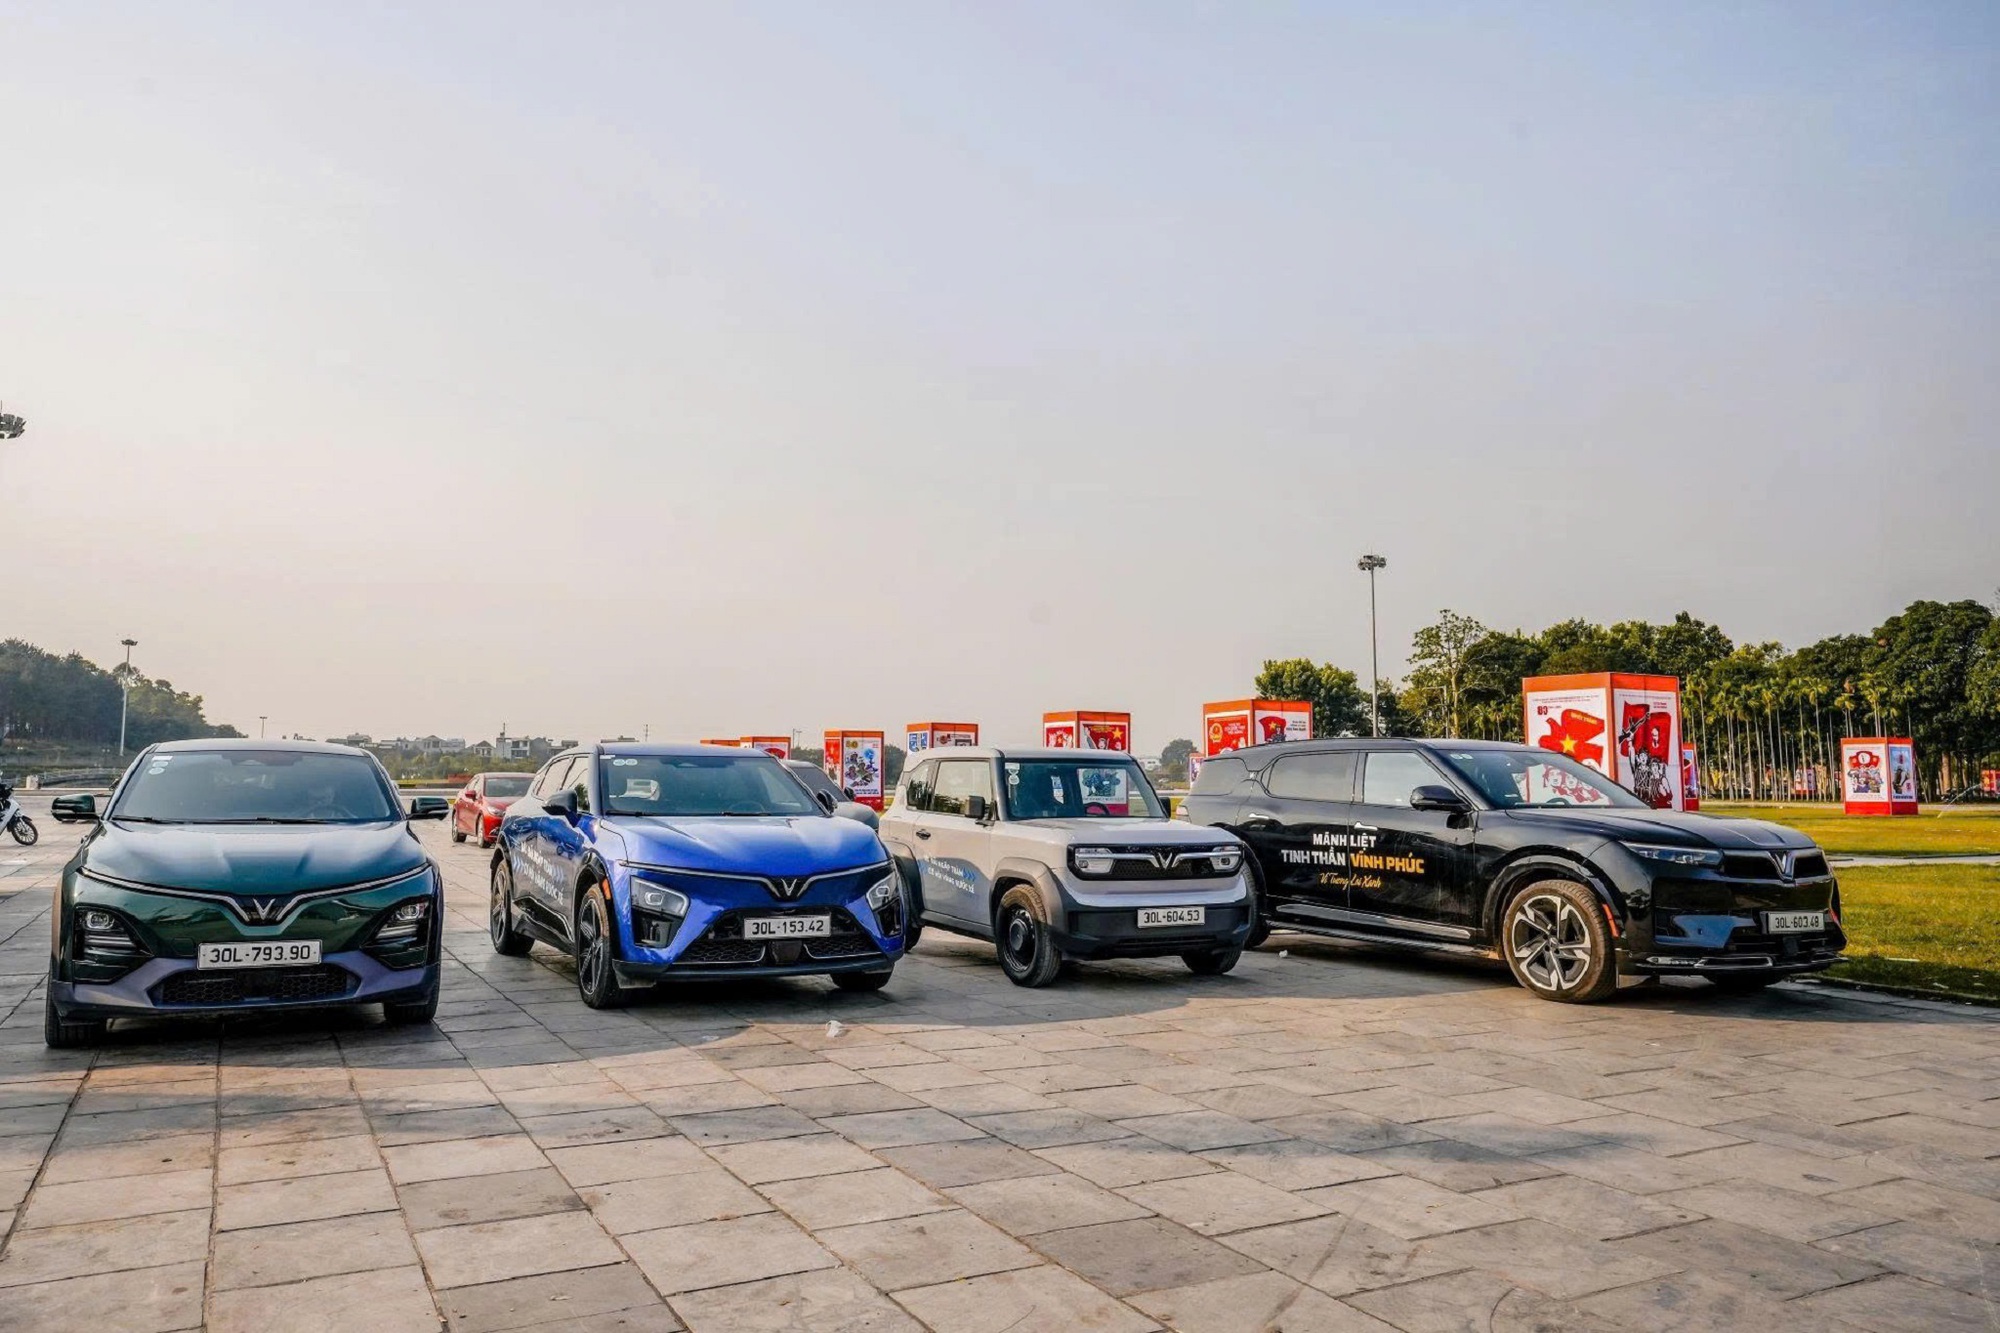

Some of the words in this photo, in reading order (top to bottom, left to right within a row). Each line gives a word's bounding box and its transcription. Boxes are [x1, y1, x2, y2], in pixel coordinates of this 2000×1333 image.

[1313, 832, 1347, 847] MÃNH
[1350, 833, 1377, 850] LIỆT
[1281, 849, 1311, 864] TINH
[1312, 846, 1346, 866] THẦN
[1350, 850, 1383, 869] VĨNH
[1386, 852, 1425, 874] PHÚC
[1143, 909, 1200, 924] 30L-604.53
[751, 919, 824, 935] 30L-153.42
[209, 944, 311, 963] 30L-793.90
